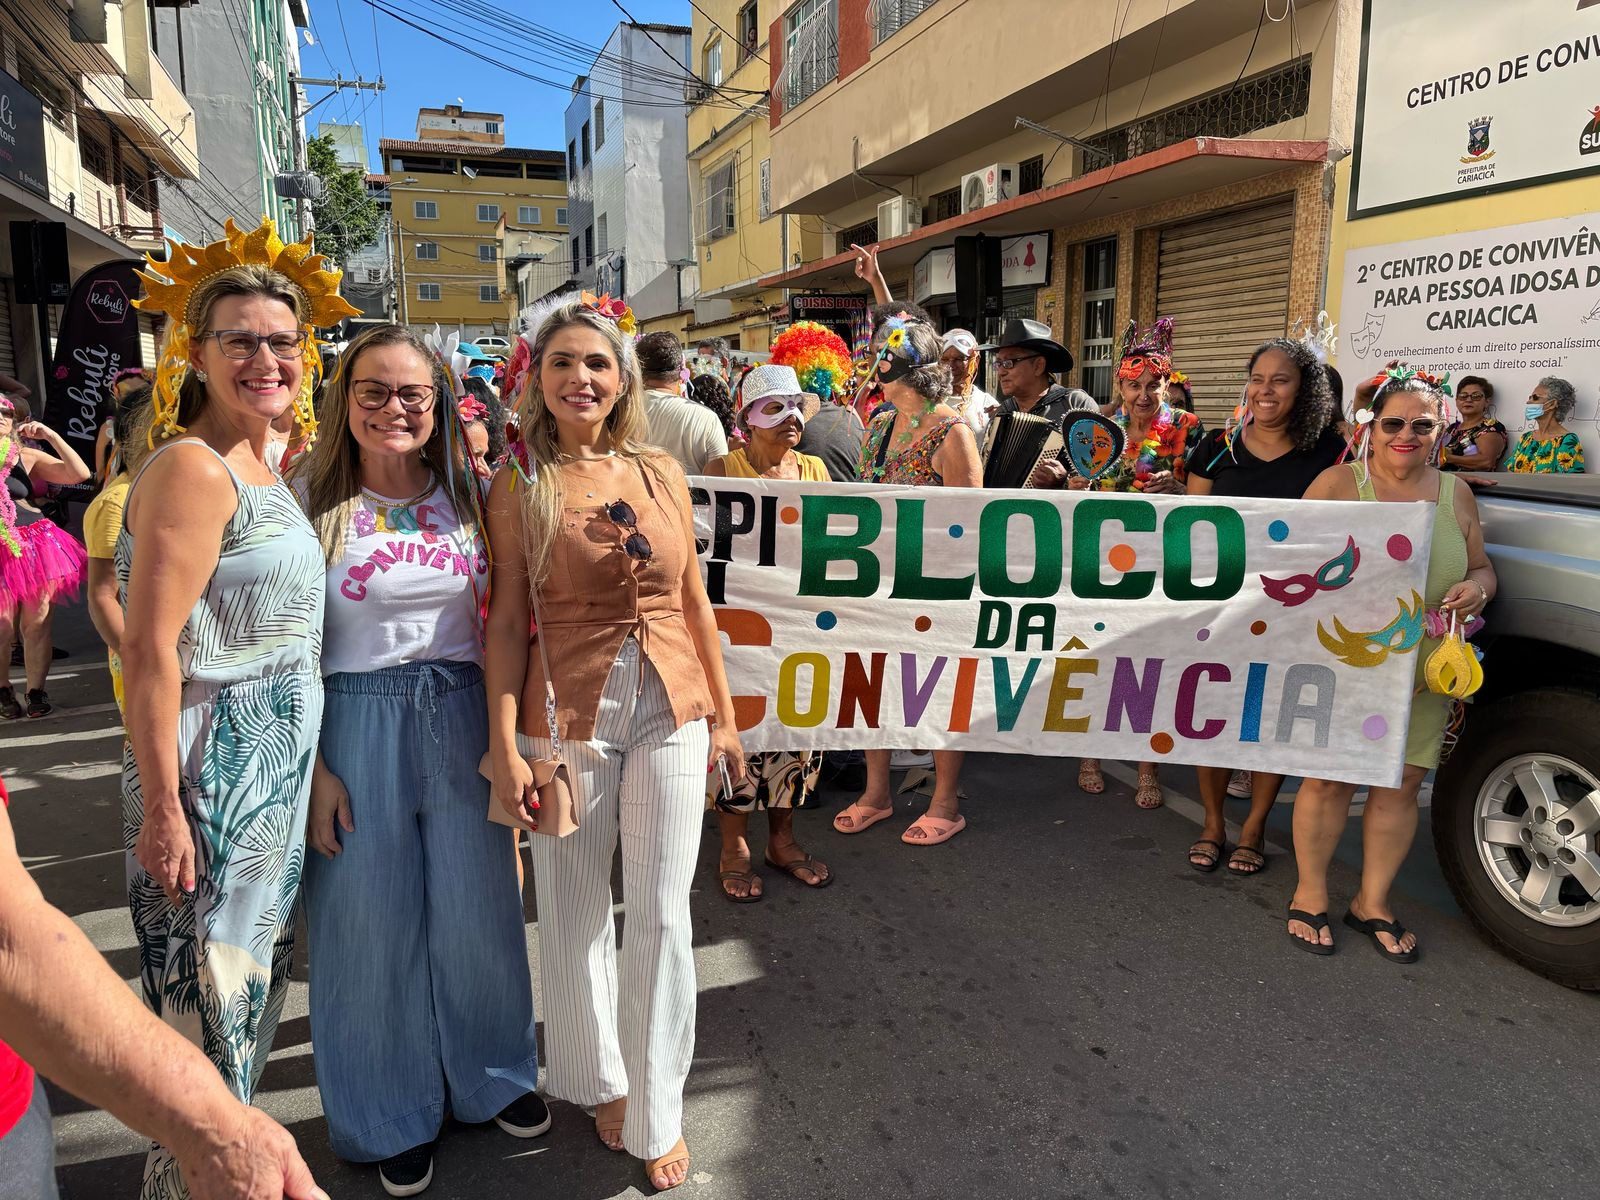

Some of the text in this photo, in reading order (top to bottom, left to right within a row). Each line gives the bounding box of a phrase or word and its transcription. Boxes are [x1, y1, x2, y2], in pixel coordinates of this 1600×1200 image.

[1406, 66, 1491, 109] CENTRO
[1498, 54, 1529, 84] DE
[1457, 162, 1496, 176] PREFEITURA DE
[1457, 170, 1496, 184] CARIACICA
[1380, 252, 1454, 281] CENTRO
[1458, 248, 1484, 271] DE
[91, 292, 124, 312] Rebuli
[793, 296, 865, 309] COISAS BOAS
[1373, 285, 1422, 309] PARA
[1426, 275, 1504, 303] PESSOA
[1510, 267, 1580, 295] IDOSA
[1426, 303, 1538, 332] CARIACICA
[1384, 345, 1455, 358] envelhecimento
[1457, 343, 1464, 353] é
[1466, 344, 1481, 353] um
[1484, 341, 1518, 353] direito
[103, 353, 121, 389] Store
[1410, 363, 1426, 372] sua
[1428, 360, 1472, 374] proteção,
[1475, 361, 1490, 370] um
[1493, 358, 1527, 370] direito
[67, 344, 109, 441] Rebuli
[796, 494, 1246, 601] BLOCO
[973, 600, 1057, 651] DA
